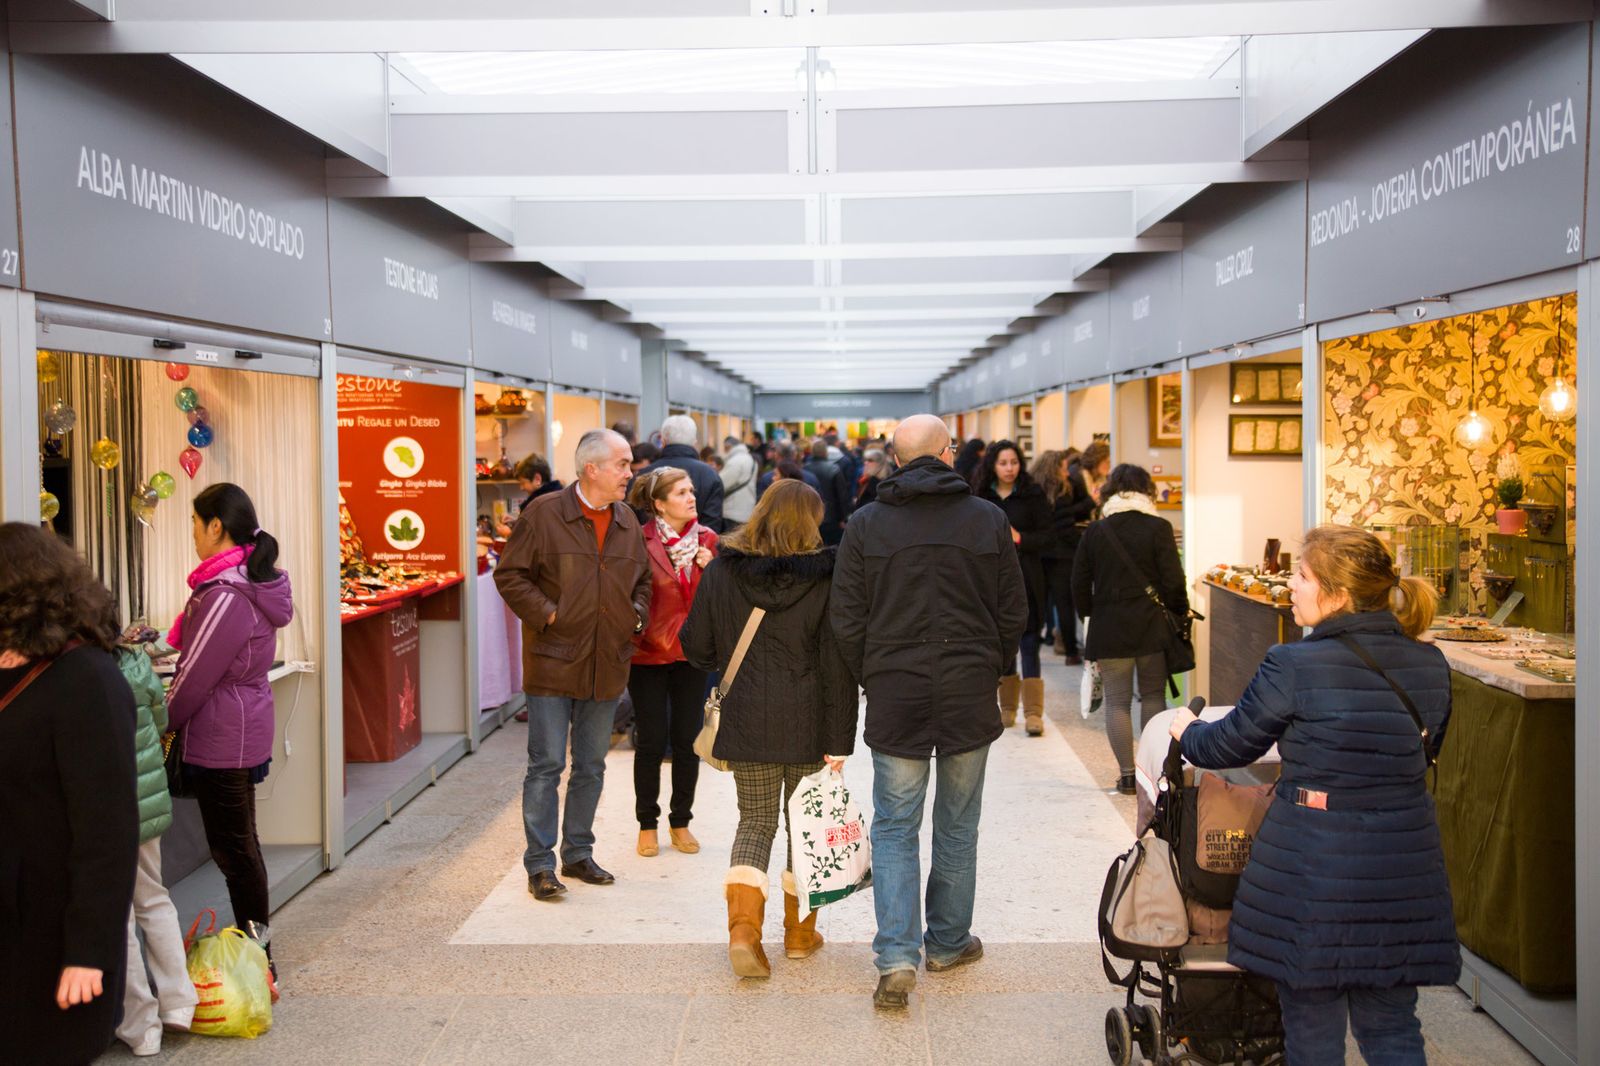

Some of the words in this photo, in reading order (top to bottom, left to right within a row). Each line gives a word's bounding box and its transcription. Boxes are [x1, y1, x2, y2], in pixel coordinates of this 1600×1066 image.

[1310, 196, 1359, 248] REDONDA
[1368, 168, 1418, 224] JOYERIA
[1421, 97, 1577, 201] CONTEMPORÁNEA
[77, 145, 126, 201] ALBA
[131, 164, 195, 224] MARTIN
[197, 185, 246, 240] VIDRIO
[248, 207, 305, 261] SOPLADO
[1565, 226, 1581, 255] 28
[2, 248, 19, 277] 27
[384, 257, 417, 293] TESTONE
[416, 268, 439, 300] HOJAS
[1215, 257, 1236, 288] TALLER
[1234, 245, 1255, 282] CRUZ
[337, 376, 402, 393] estone
[1206, 843, 1229, 851] STREET
